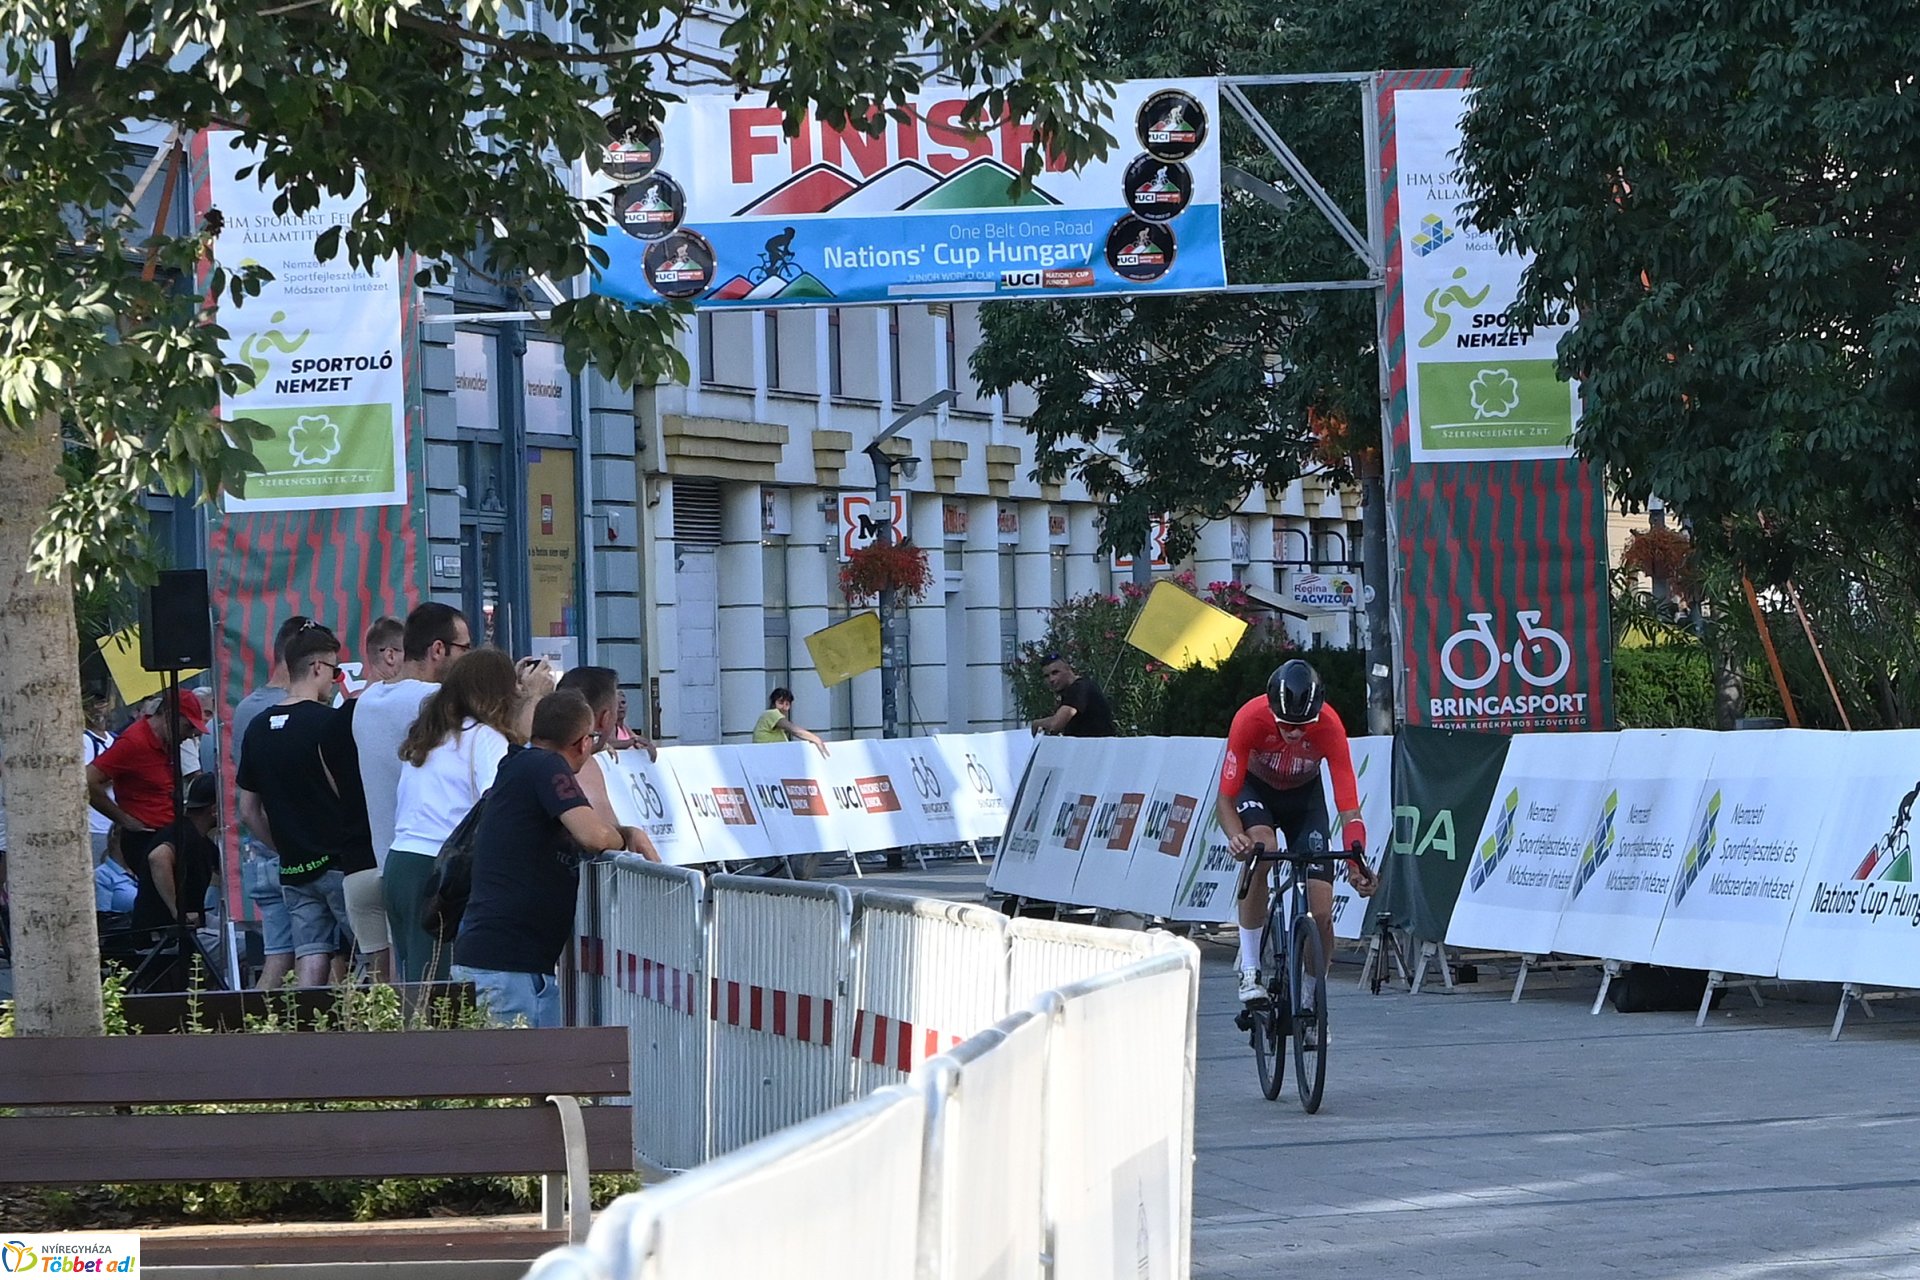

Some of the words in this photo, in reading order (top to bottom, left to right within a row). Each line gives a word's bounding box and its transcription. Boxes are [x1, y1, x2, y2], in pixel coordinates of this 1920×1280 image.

[1407, 173, 1433, 186] HM
[224, 216, 249, 230] HM
[950, 224, 981, 240] One
[985, 223, 1014, 239] Belt
[1019, 222, 1050, 237] One
[1055, 219, 1094, 236] Road
[824, 244, 926, 269] Nations'
[933, 243, 980, 269] Cup
[989, 240, 1093, 266] Hungary
[1008, 273, 1040, 287] UCI
[1076, 270, 1090, 278] CUP
[284, 285, 350, 295] Módszertani
[353, 282, 389, 293] Intézet
[1457, 331, 1530, 348] NEMZET
[291, 350, 393, 374] SPORTOLÓ
[275, 377, 353, 394] NEMZET
[1294, 584, 1328, 595] Regina
[1430, 693, 1588, 717] BRINGASPORT
[1470, 719, 1531, 730] KERÉKPÁROS
[1731, 803, 1767, 825] Nemzeti
[1719, 837, 1784, 866] Sportfejlesztési
[1784, 840, 1798, 863] és
[1709, 872, 1760, 897] Módszertani
[1759, 874, 1795, 900] Intézet
[1860, 883, 1888, 924] Cup
